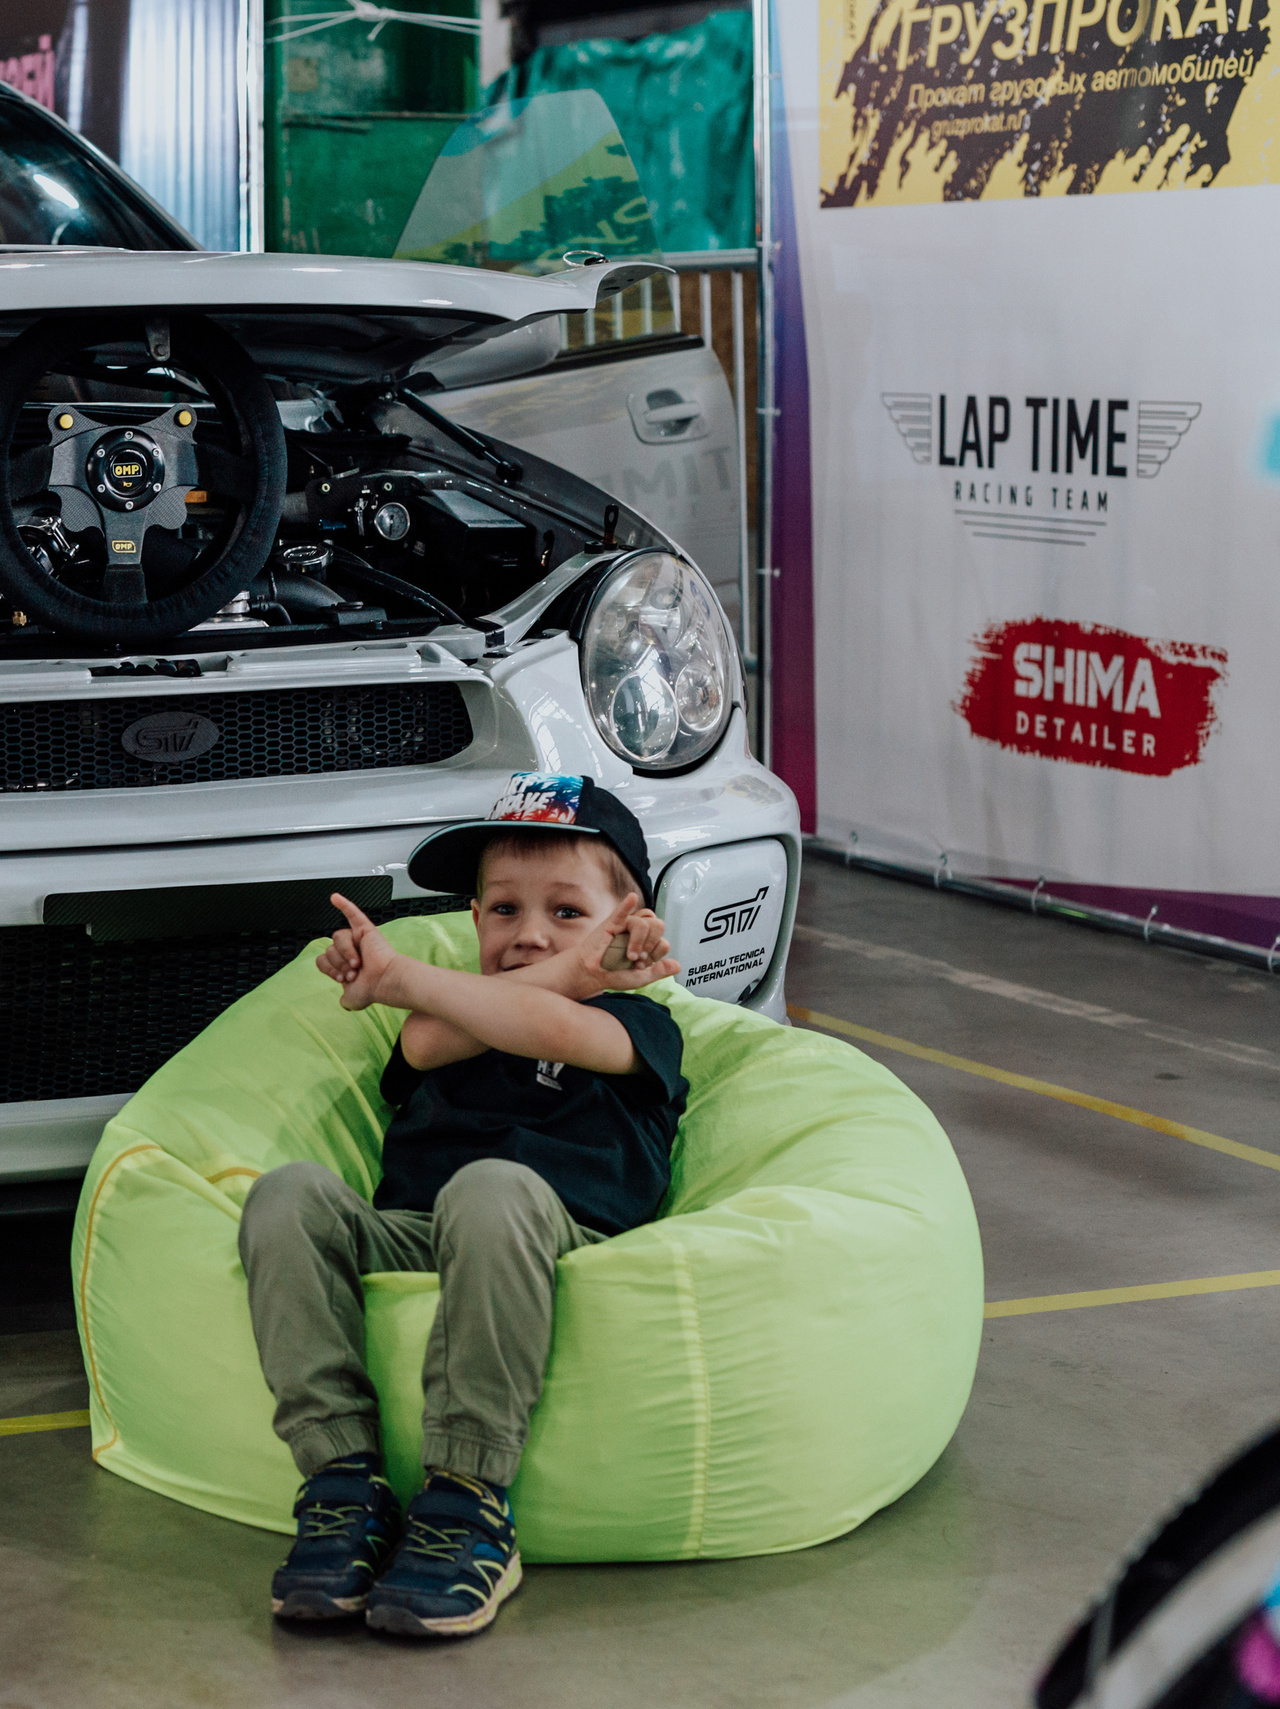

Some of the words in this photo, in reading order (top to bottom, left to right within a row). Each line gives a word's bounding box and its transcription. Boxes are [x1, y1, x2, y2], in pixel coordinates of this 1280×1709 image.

[907, 83, 986, 114] Прокат
[989, 71, 1087, 107] грузоых
[1091, 48, 1254, 92] автомобилей
[939, 394, 1011, 469] LAP
[1025, 397, 1129, 477] TIME
[114, 464, 140, 476] OMP
[955, 481, 1033, 507] RACING
[1052, 487, 1109, 512] TEAM
[114, 543, 133, 551] OMP
[1013, 641, 1162, 718] SHIMA
[1015, 711, 1156, 757] DETAILER
[685, 957, 764, 988] INTERNATIONAL
[687, 958, 727, 977] SUBARU
[729, 947, 766, 965] TECNICA
